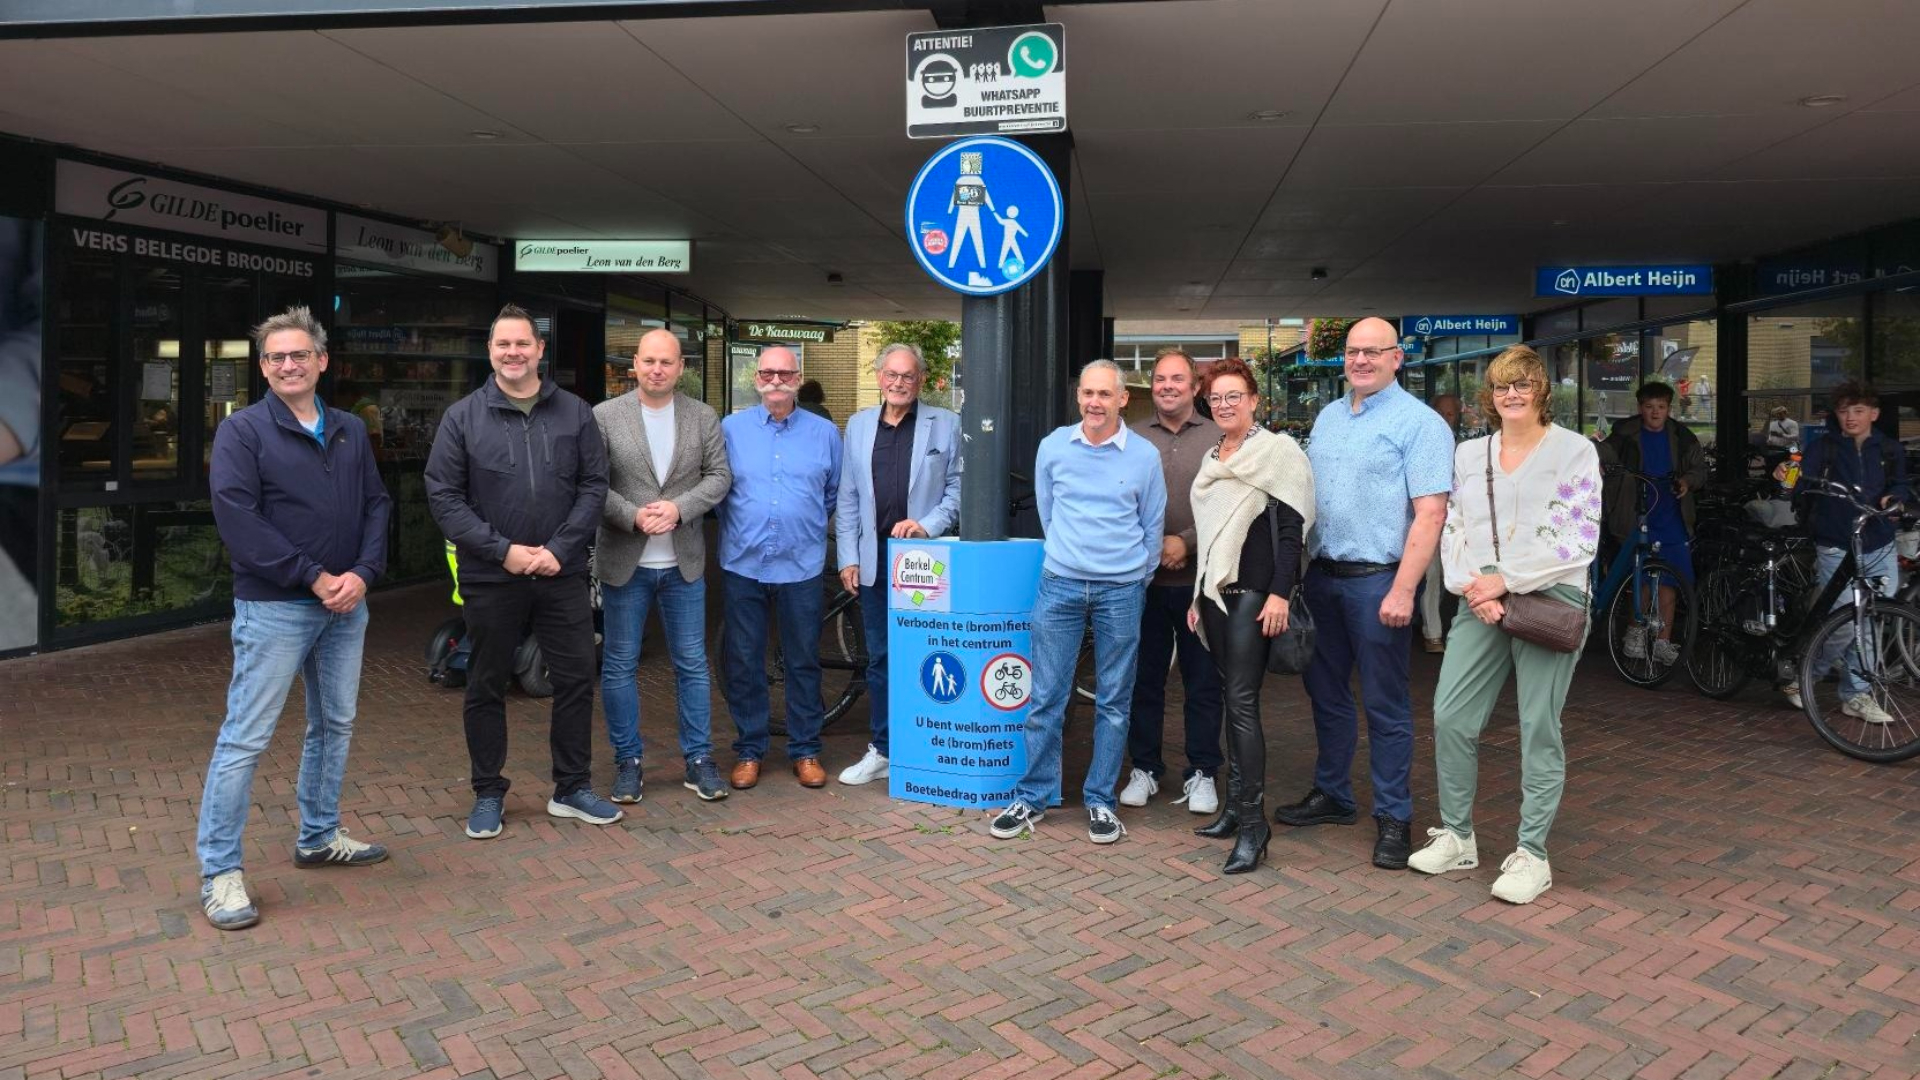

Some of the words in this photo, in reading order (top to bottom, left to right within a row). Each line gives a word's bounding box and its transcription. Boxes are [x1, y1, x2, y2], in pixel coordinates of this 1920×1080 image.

[913, 35, 973, 51] ATTENTIE!
[981, 88, 1041, 102] WHATSAPP
[963, 102, 1059, 118] BUURTPREVENTIE
[357, 226, 394, 252] Leon
[427, 241, 451, 262] den
[73, 228, 128, 253] VERS
[134, 237, 222, 266] BELEGDE
[226, 251, 314, 278] BROODJES
[586, 256, 612, 267] Leon
[614, 258, 632, 267] van
[635, 256, 654, 267] den
[657, 256, 682, 269] Berg
[1583, 271, 1642, 287] Albert
[1648, 270, 1696, 289] Heijn
[748, 324, 764, 337] De
[765, 325, 826, 342] Kaaswaag
[1434, 319, 1472, 330] Albert
[1475, 318, 1507, 332] Heijn
[1397, 342, 1414, 350] eijn
[904, 557, 931, 571] Berkel
[900, 571, 934, 584] Centrum
[896, 616, 949, 631] Verboden
[952, 621, 963, 631] te
[965, 619, 1031, 633] (brom)fiets
[927, 635, 939, 646] in
[942, 635, 960, 647] het
[962, 638, 1012, 649] centrum
[916, 716, 924, 727] U
[926, 717, 952, 730] bent
[954, 720, 1001, 734] welkom
[1004, 724, 1024, 732] me
[931, 735, 945, 747] de
[947, 736, 1014, 752] (brom)fiets
[937, 755, 958, 765] aan
[961, 755, 976, 767] de
[978, 755, 1010, 767] hand
[905, 782, 978, 804] Boetebedrag
[980, 788, 1017, 801] vanaf
